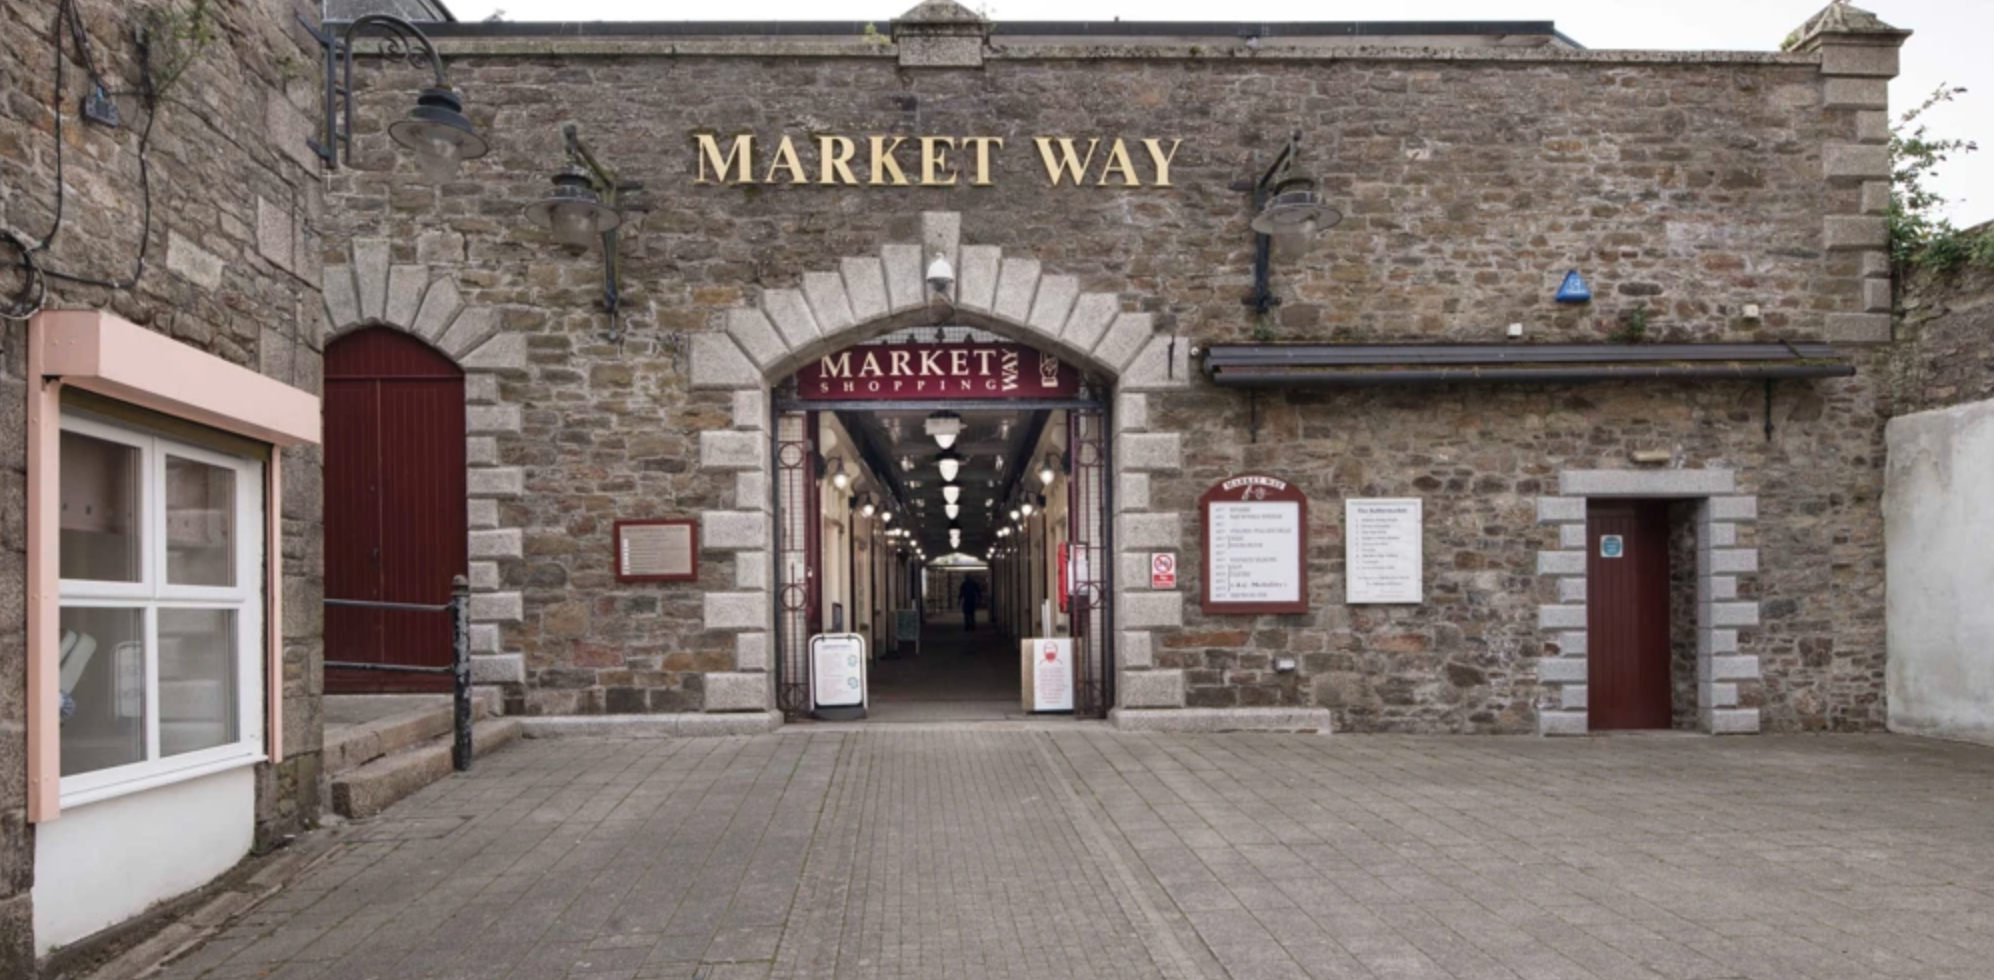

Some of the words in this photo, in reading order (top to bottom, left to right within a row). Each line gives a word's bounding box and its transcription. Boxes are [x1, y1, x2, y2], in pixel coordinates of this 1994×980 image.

[694, 134, 1003, 187] MARKET
[1032, 136, 1184, 188] WAY
[819, 350, 997, 378] MARKET
[1001, 348, 1019, 392] WAY
[819, 379, 997, 393] SHOPPING
